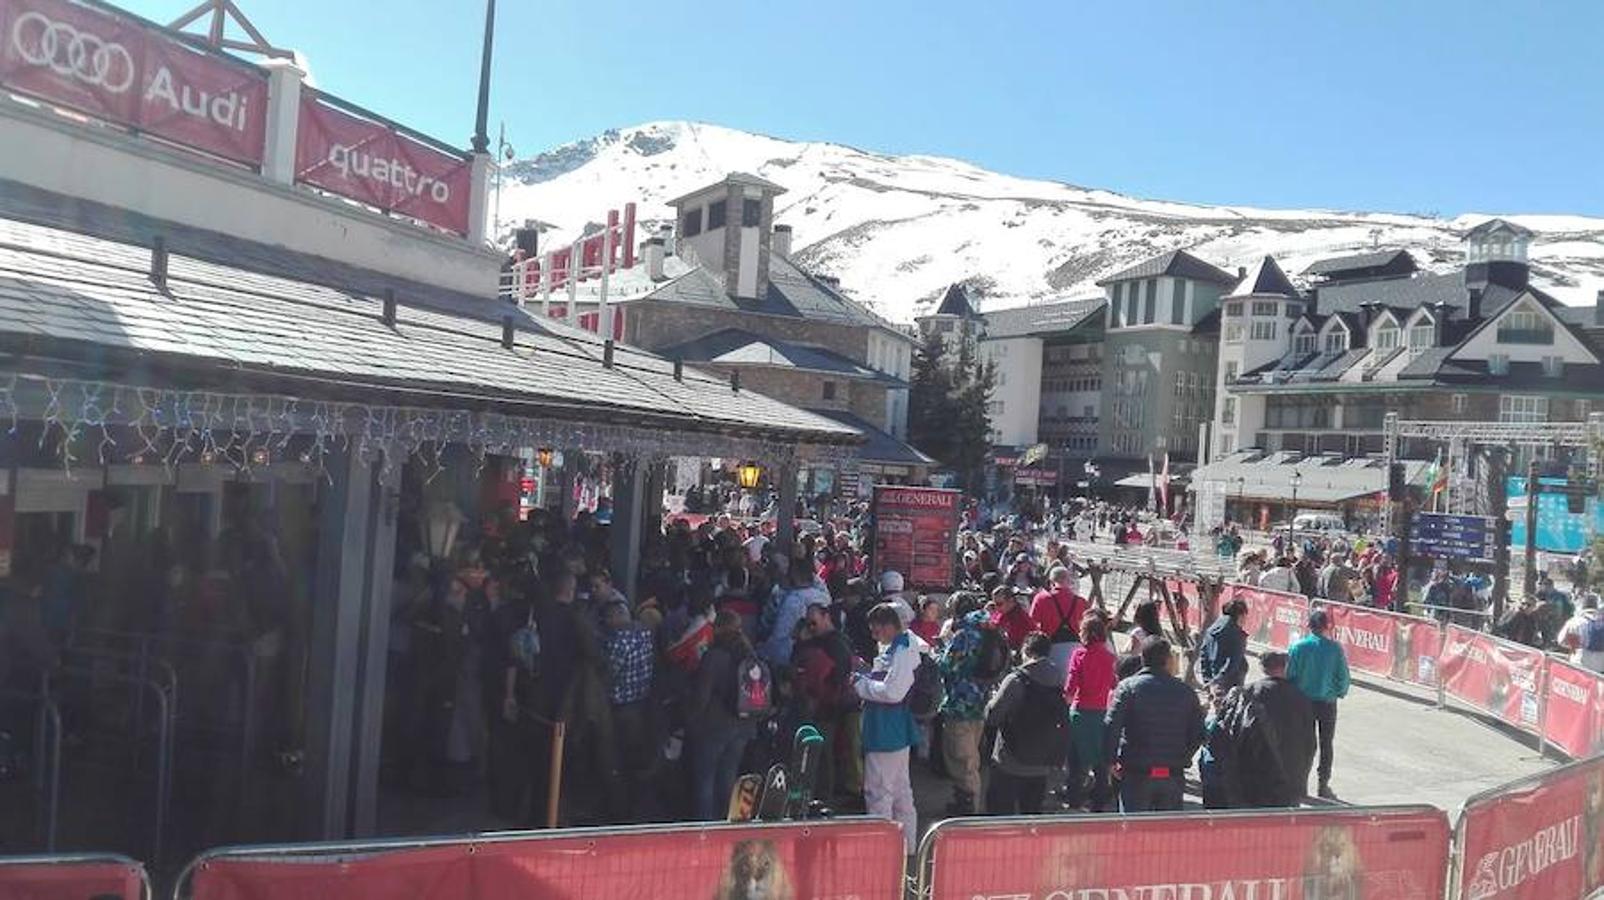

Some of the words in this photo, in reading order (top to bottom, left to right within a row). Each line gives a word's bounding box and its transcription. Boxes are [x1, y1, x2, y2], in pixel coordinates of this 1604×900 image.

[144, 66, 248, 131] Audi
[328, 143, 449, 203] quattro
[895, 492, 952, 506] GENERALI
